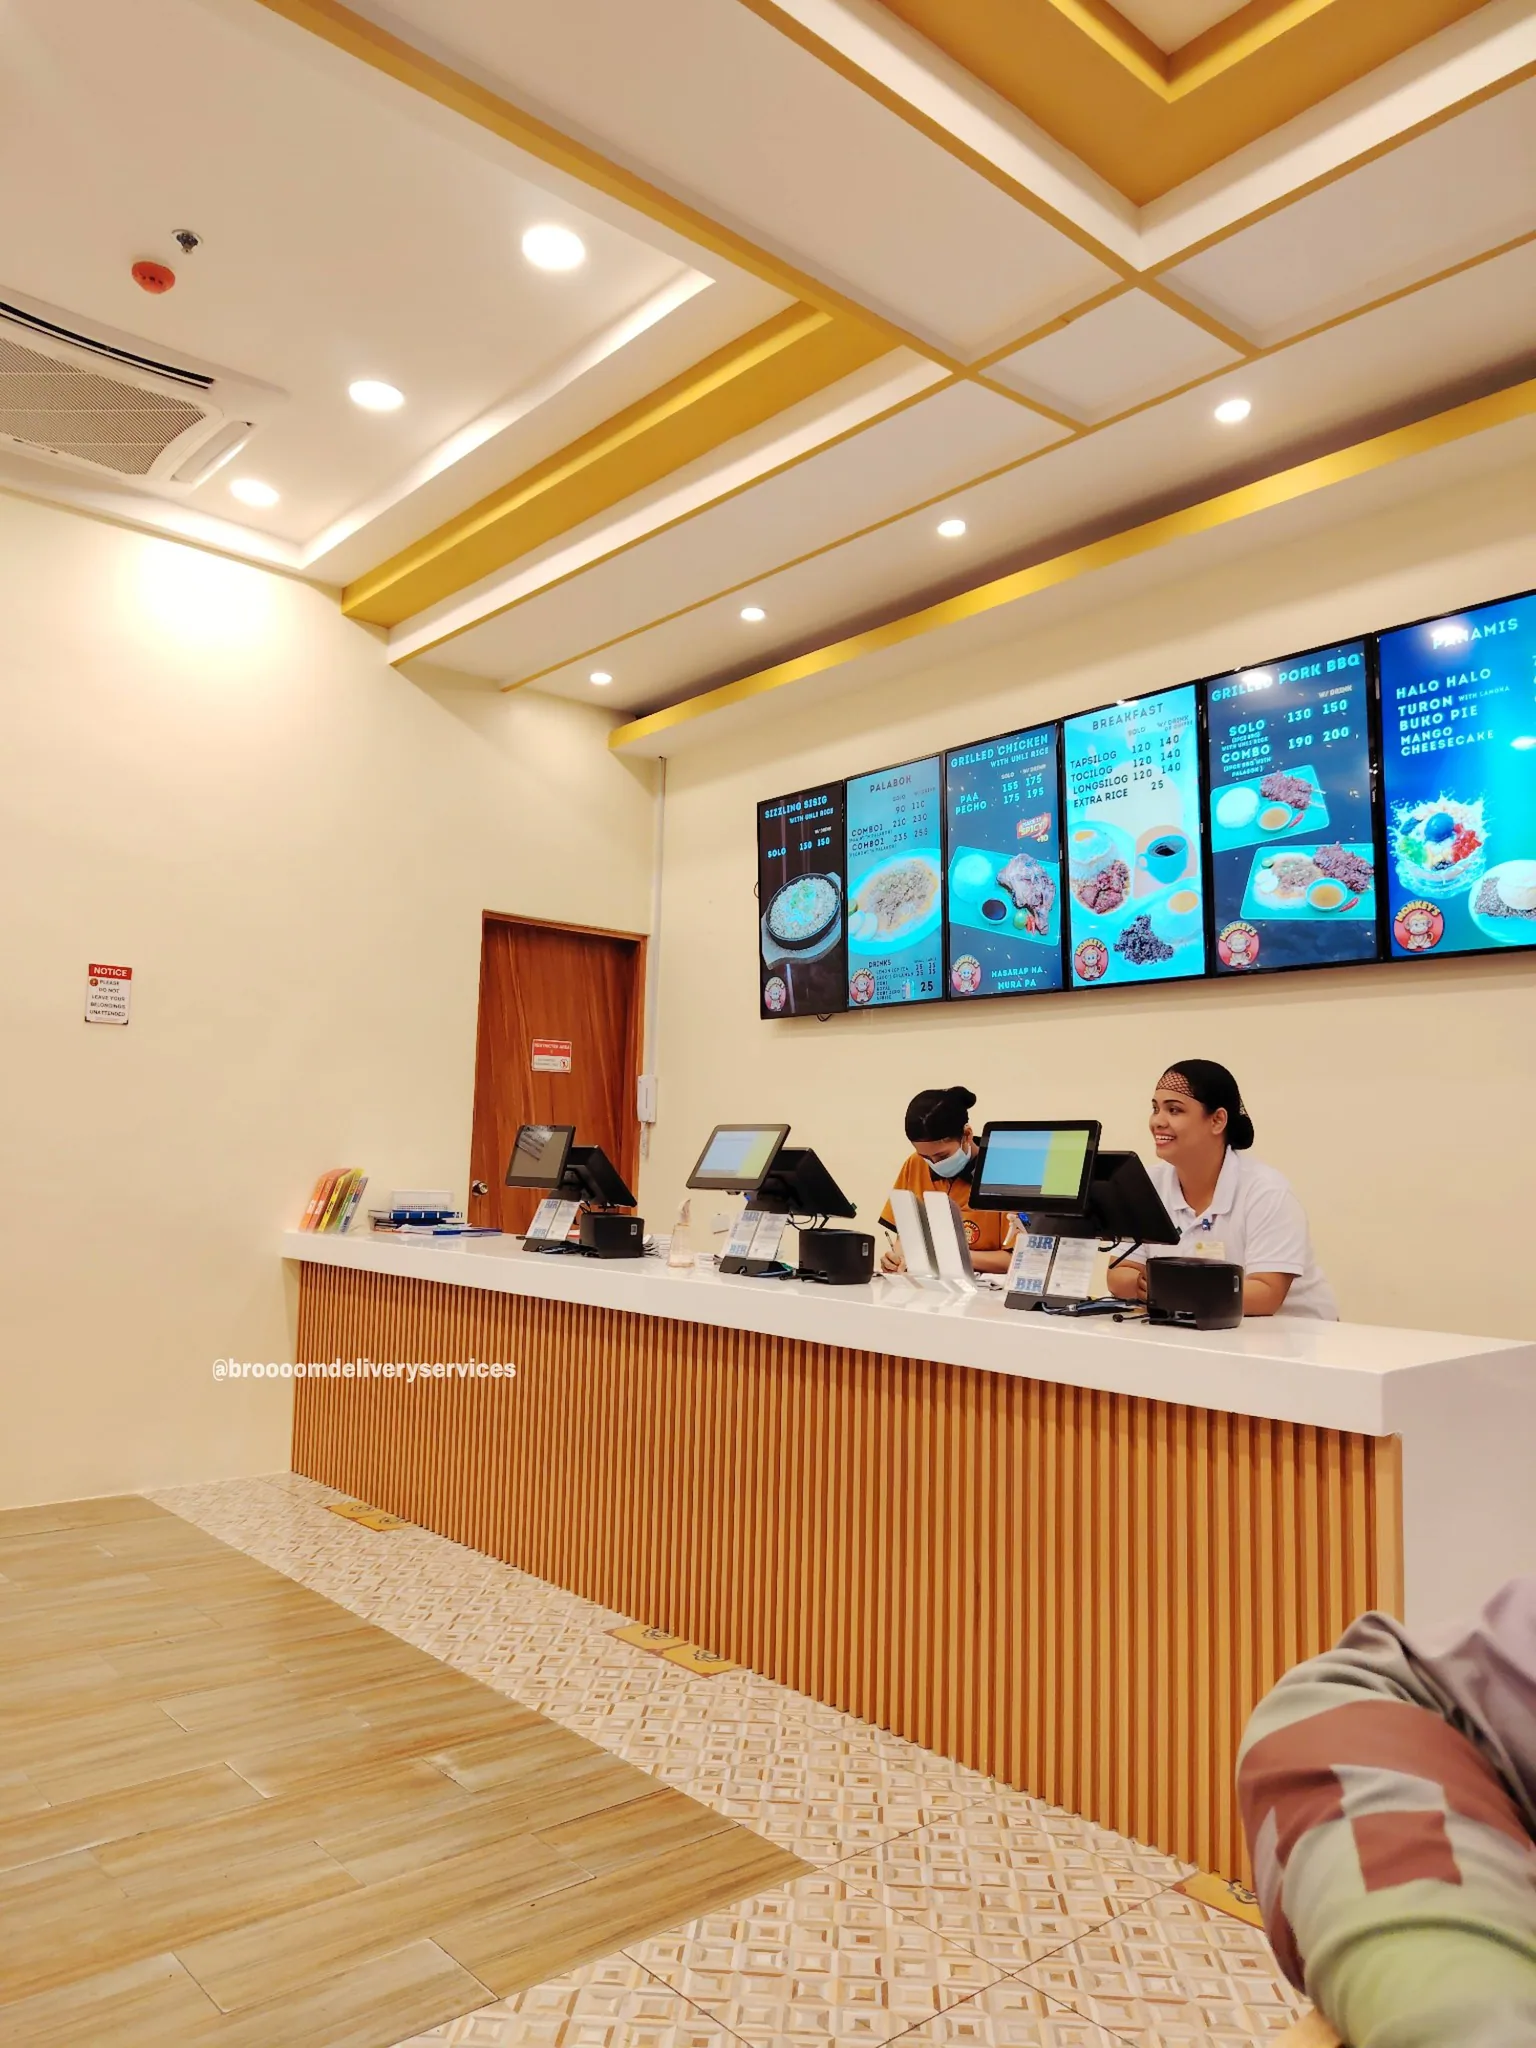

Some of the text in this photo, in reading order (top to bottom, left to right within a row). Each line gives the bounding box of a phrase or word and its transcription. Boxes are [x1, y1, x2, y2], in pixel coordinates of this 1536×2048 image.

[1279, 663, 1322, 684] PORK
[1326, 654, 1360, 672] BBQ
[1396, 668, 1491, 699] HALO HALO
[1398, 695, 1453, 716] TURON
[1458, 693, 1477, 701] WITH
[1092, 703, 1164, 730] BREAKFAST
[1167, 715, 1189, 725] DRINK
[1229, 699, 1348, 736] SOLO 130 150
[1399, 705, 1477, 731] BUKO PIE
[1222, 726, 1349, 763] COMBO 190 200
[1401, 727, 1452, 745] MANGO
[1401, 730, 1494, 756] CHEESECAKE
[951, 734, 1048, 768] GRILLED CHICKEN
[991, 747, 1049, 768] WITH UNLI RICE
[1070, 735, 1179, 769] TAPSILOG 120 140
[1071, 749, 1180, 782] TOCILOG 120 140
[870, 775, 912, 792] PALABOK
[960, 773, 1042, 804] PAA 155 175
[1073, 762, 1180, 794] LONGSILOG 120 140
[955, 787, 1044, 815] PECHO 175 195
[1074, 780, 1164, 808] EXTRA RICE 25
[765, 795, 827, 818] SIZZLING SISIG
[789, 815, 803, 823] WITH
[820, 808, 834, 816] RICE
[896, 801, 925, 814] 90 110
[893, 818, 906, 828] 210
[913, 813, 927, 823] 230
[768, 847, 786, 858] SOLO
[817, 837, 830, 846] 150
[893, 833, 908, 842] 235
[1037, 834, 1048, 842] +10
[94, 967, 127, 976] NOTICE
[868, 960, 891, 968] DRINKS
[992, 967, 1028, 977] MASARAP
[921, 981, 933, 992] 25
[998, 979, 1036, 990] MURA PA
[1027, 1236, 1054, 1249] BIR
[1015, 1278, 1042, 1292] BIR
